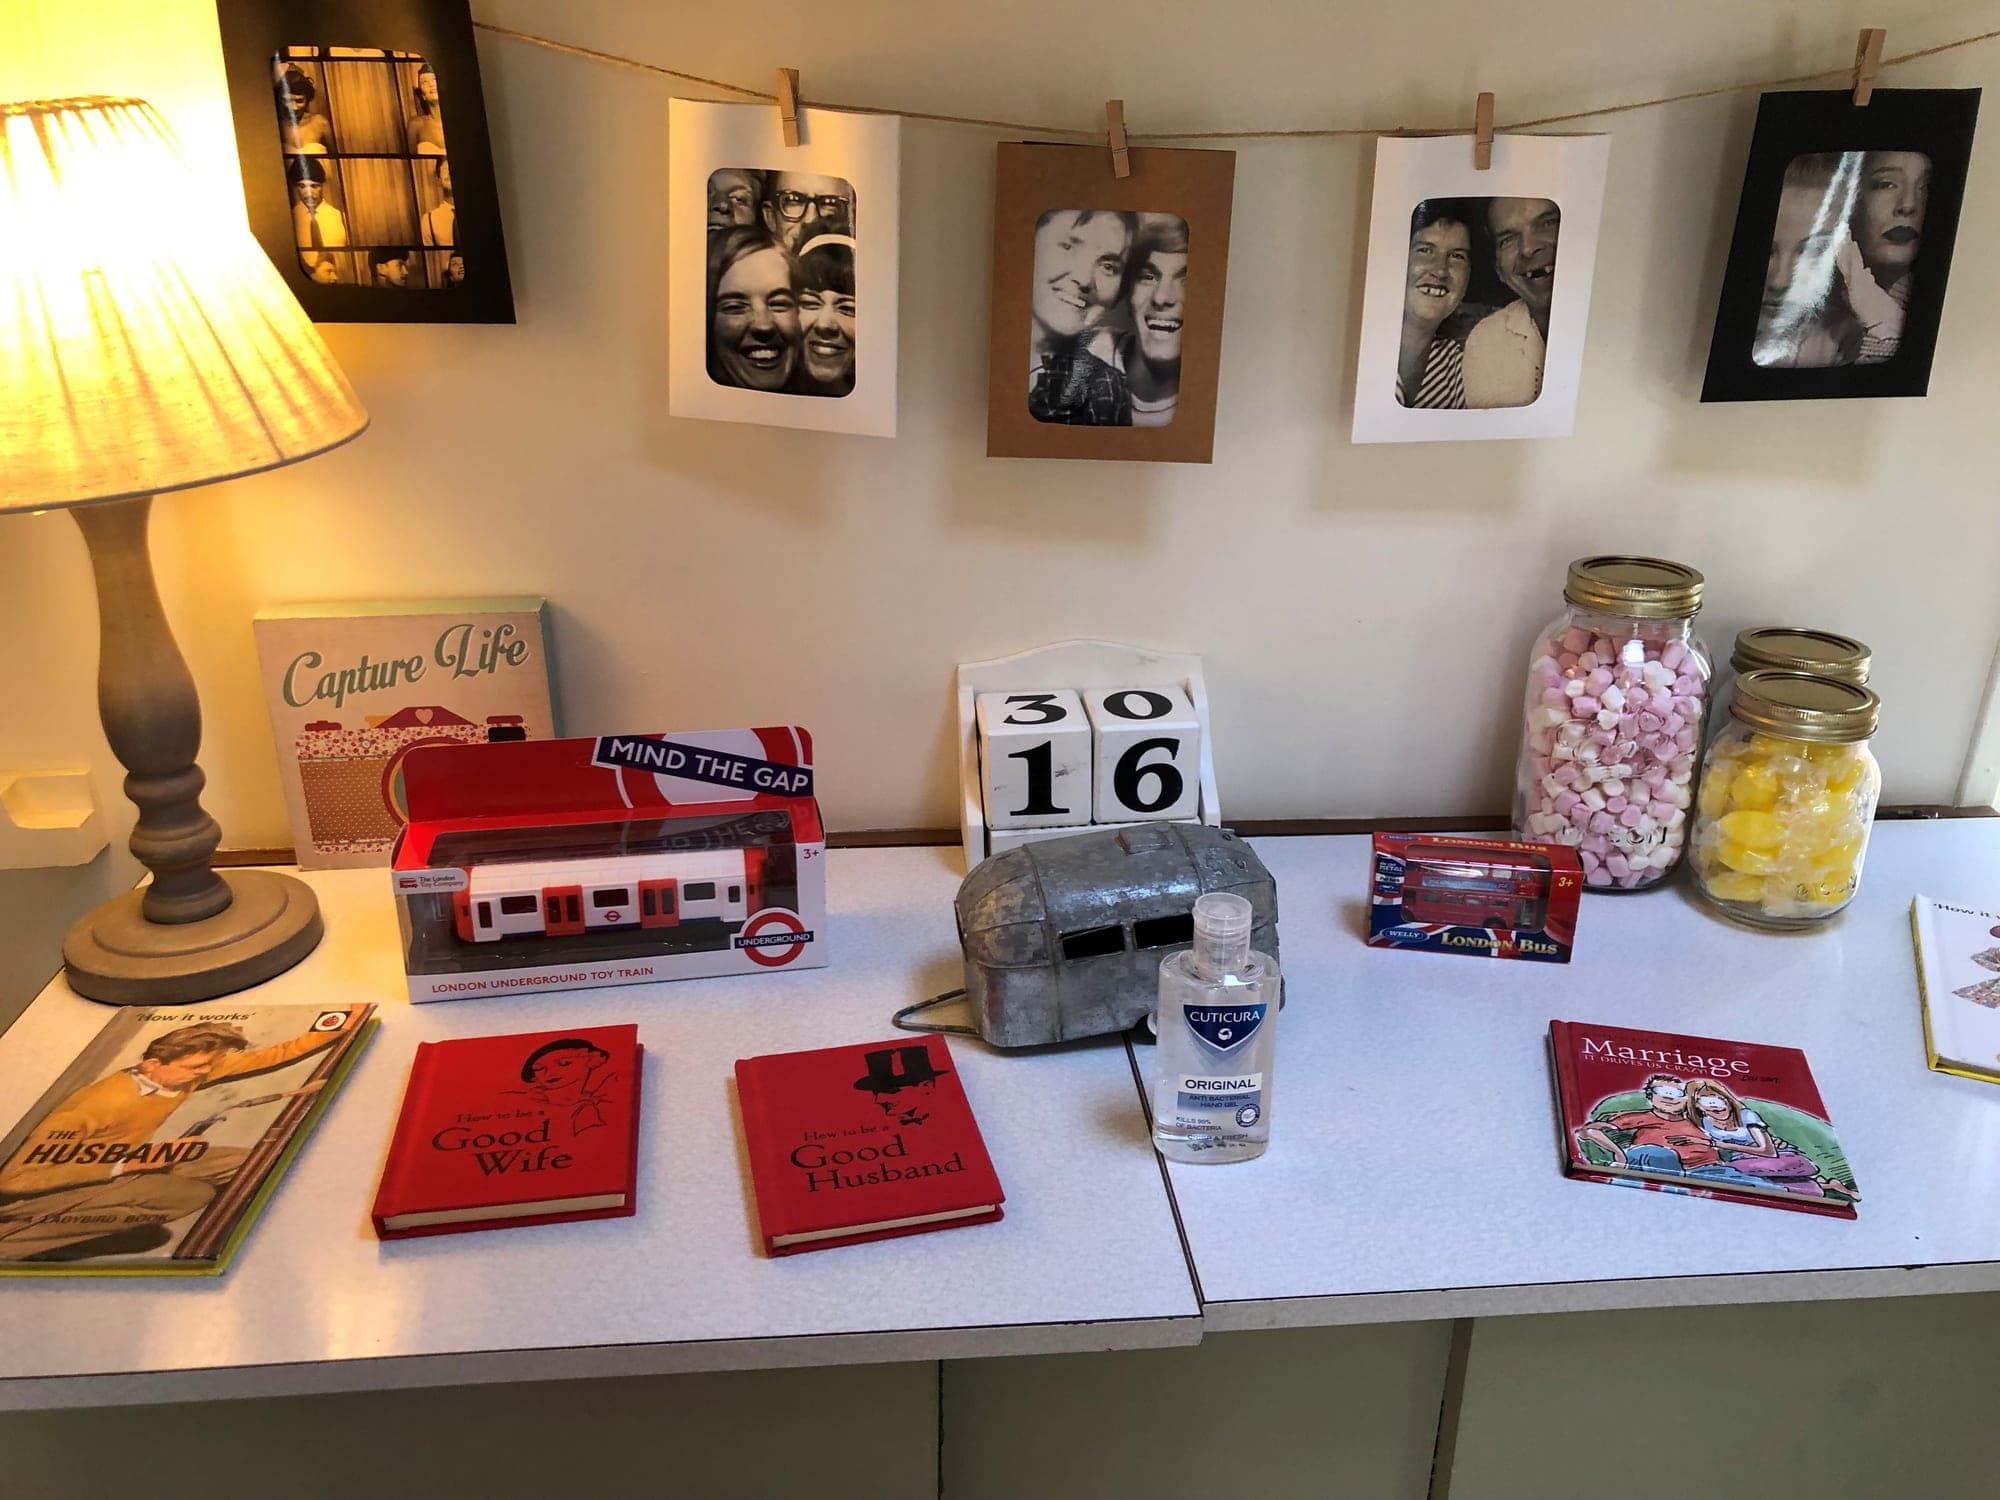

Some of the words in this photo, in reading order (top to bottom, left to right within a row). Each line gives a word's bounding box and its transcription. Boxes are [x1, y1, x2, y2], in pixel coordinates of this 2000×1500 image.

[283, 649, 426, 707] Capture
[434, 623, 529, 679] Life
[1003, 694, 1067, 724] 3
[1103, 690, 1172, 719] 0
[610, 739, 686, 770] MIND
[695, 754, 746, 782] THE
[753, 766, 808, 793] GAP
[1008, 740, 1070, 816] 1
[1113, 737, 1183, 813] 6
[803, 849, 820, 859] 3+
[1558, 877, 1573, 886] 3+
[738, 932, 810, 947] UNDERGROUND
[1389, 930, 1420, 938] WELLY
[432, 979, 485, 993] LONDON
[490, 973, 585, 989] UNDERGROUND
[590, 971, 613, 980] TOY
[618, 967, 653, 977] TRAIN
[181, 1012, 197, 1021] it
[1190, 1010, 1260, 1022] CUTICURA
[1581, 1037, 1750, 1076] Marriage
[1600, 1057, 1643, 1067] DRIVES
[1185, 1079, 1256, 1090] ORIGINAL
[456, 1111, 491, 1122] How
[515, 1109, 533, 1118] be
[47, 1131, 77, 1140] THE
[431, 1120, 550, 1151] Good
[803, 1131, 836, 1141] How
[860, 1125, 877, 1134] be
[24, 1141, 209, 1165] HUSBAND
[472, 1145, 573, 1176] Wife
[790, 1134, 908, 1169] Good
[805, 1151, 966, 1192] Husband
